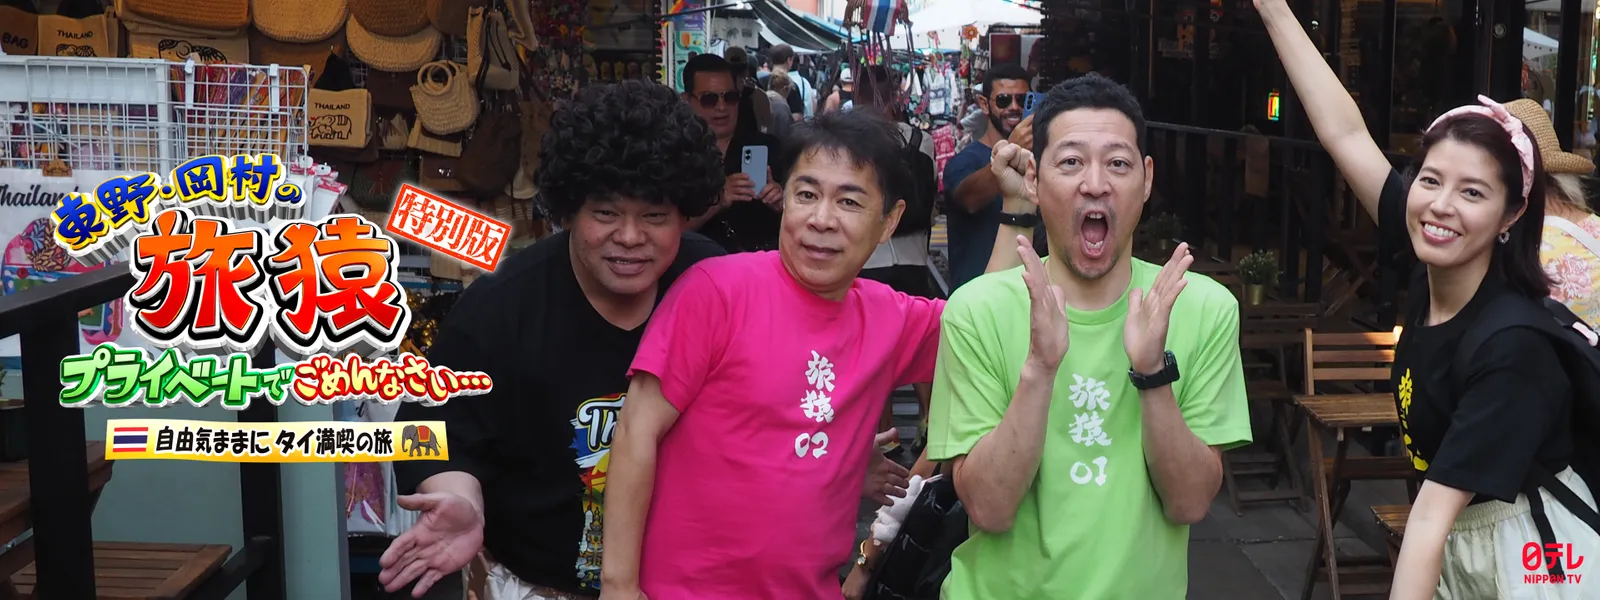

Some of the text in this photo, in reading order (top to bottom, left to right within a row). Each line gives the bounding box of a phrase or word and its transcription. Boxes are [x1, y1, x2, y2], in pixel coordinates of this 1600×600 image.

[2, 32, 29, 49] BAG
[57, 29, 94, 40] THAILAND
[314, 102, 351, 110] THAILAND
[800, 350, 836, 423] 旅猿
[1068, 373, 1112, 447] 旅猿
[794, 431, 829, 459] 02
[1070, 455, 1108, 487] 01
